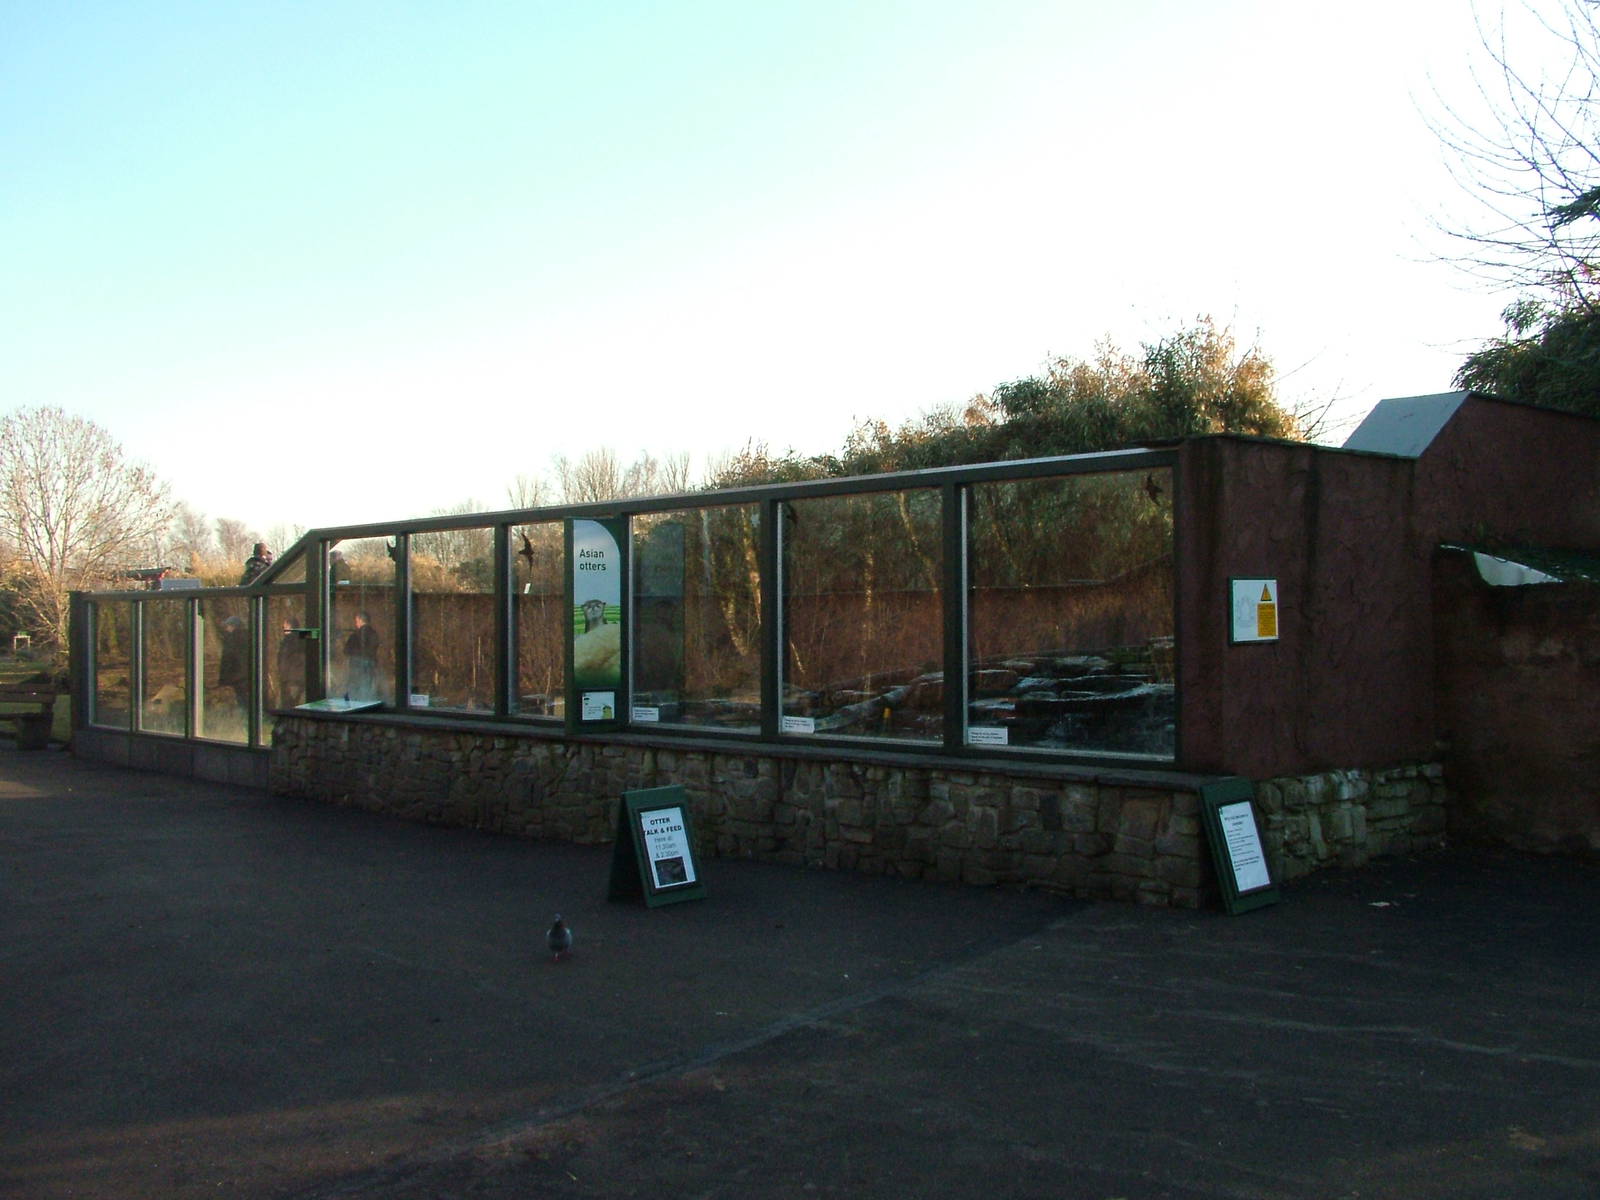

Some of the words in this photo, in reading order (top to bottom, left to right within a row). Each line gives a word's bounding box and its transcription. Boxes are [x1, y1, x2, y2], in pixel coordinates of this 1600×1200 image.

[580, 549, 604, 558] Asian
[580, 562, 606, 570] otters
[650, 817, 671, 825] OTTER
